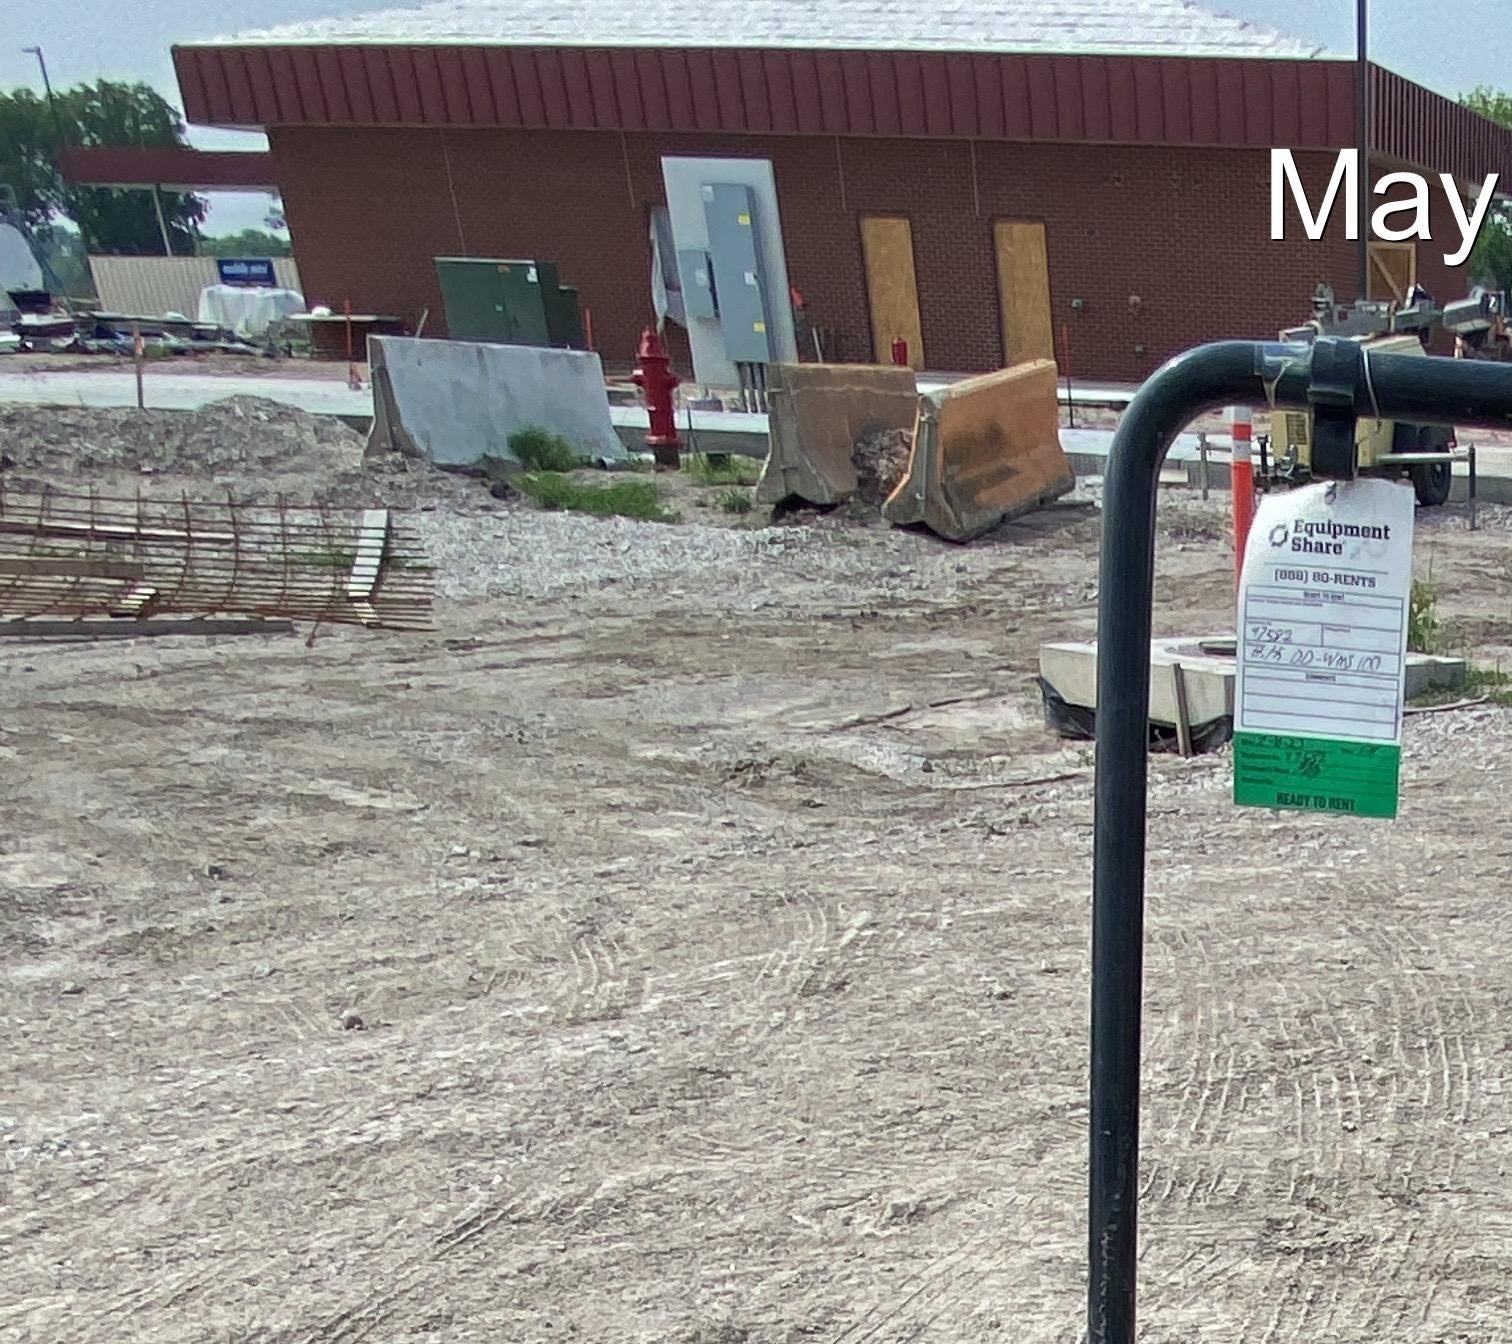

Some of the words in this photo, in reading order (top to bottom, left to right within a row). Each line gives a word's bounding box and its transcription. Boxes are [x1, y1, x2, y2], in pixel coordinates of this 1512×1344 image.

[1293, 519, 1391, 541] Equipment
[1291, 536, 1343, 556] Share
[1276, 793, 1311, 807] READY
[1313, 795, 1327, 809] TO
[1328, 797, 1356, 811] RENT
